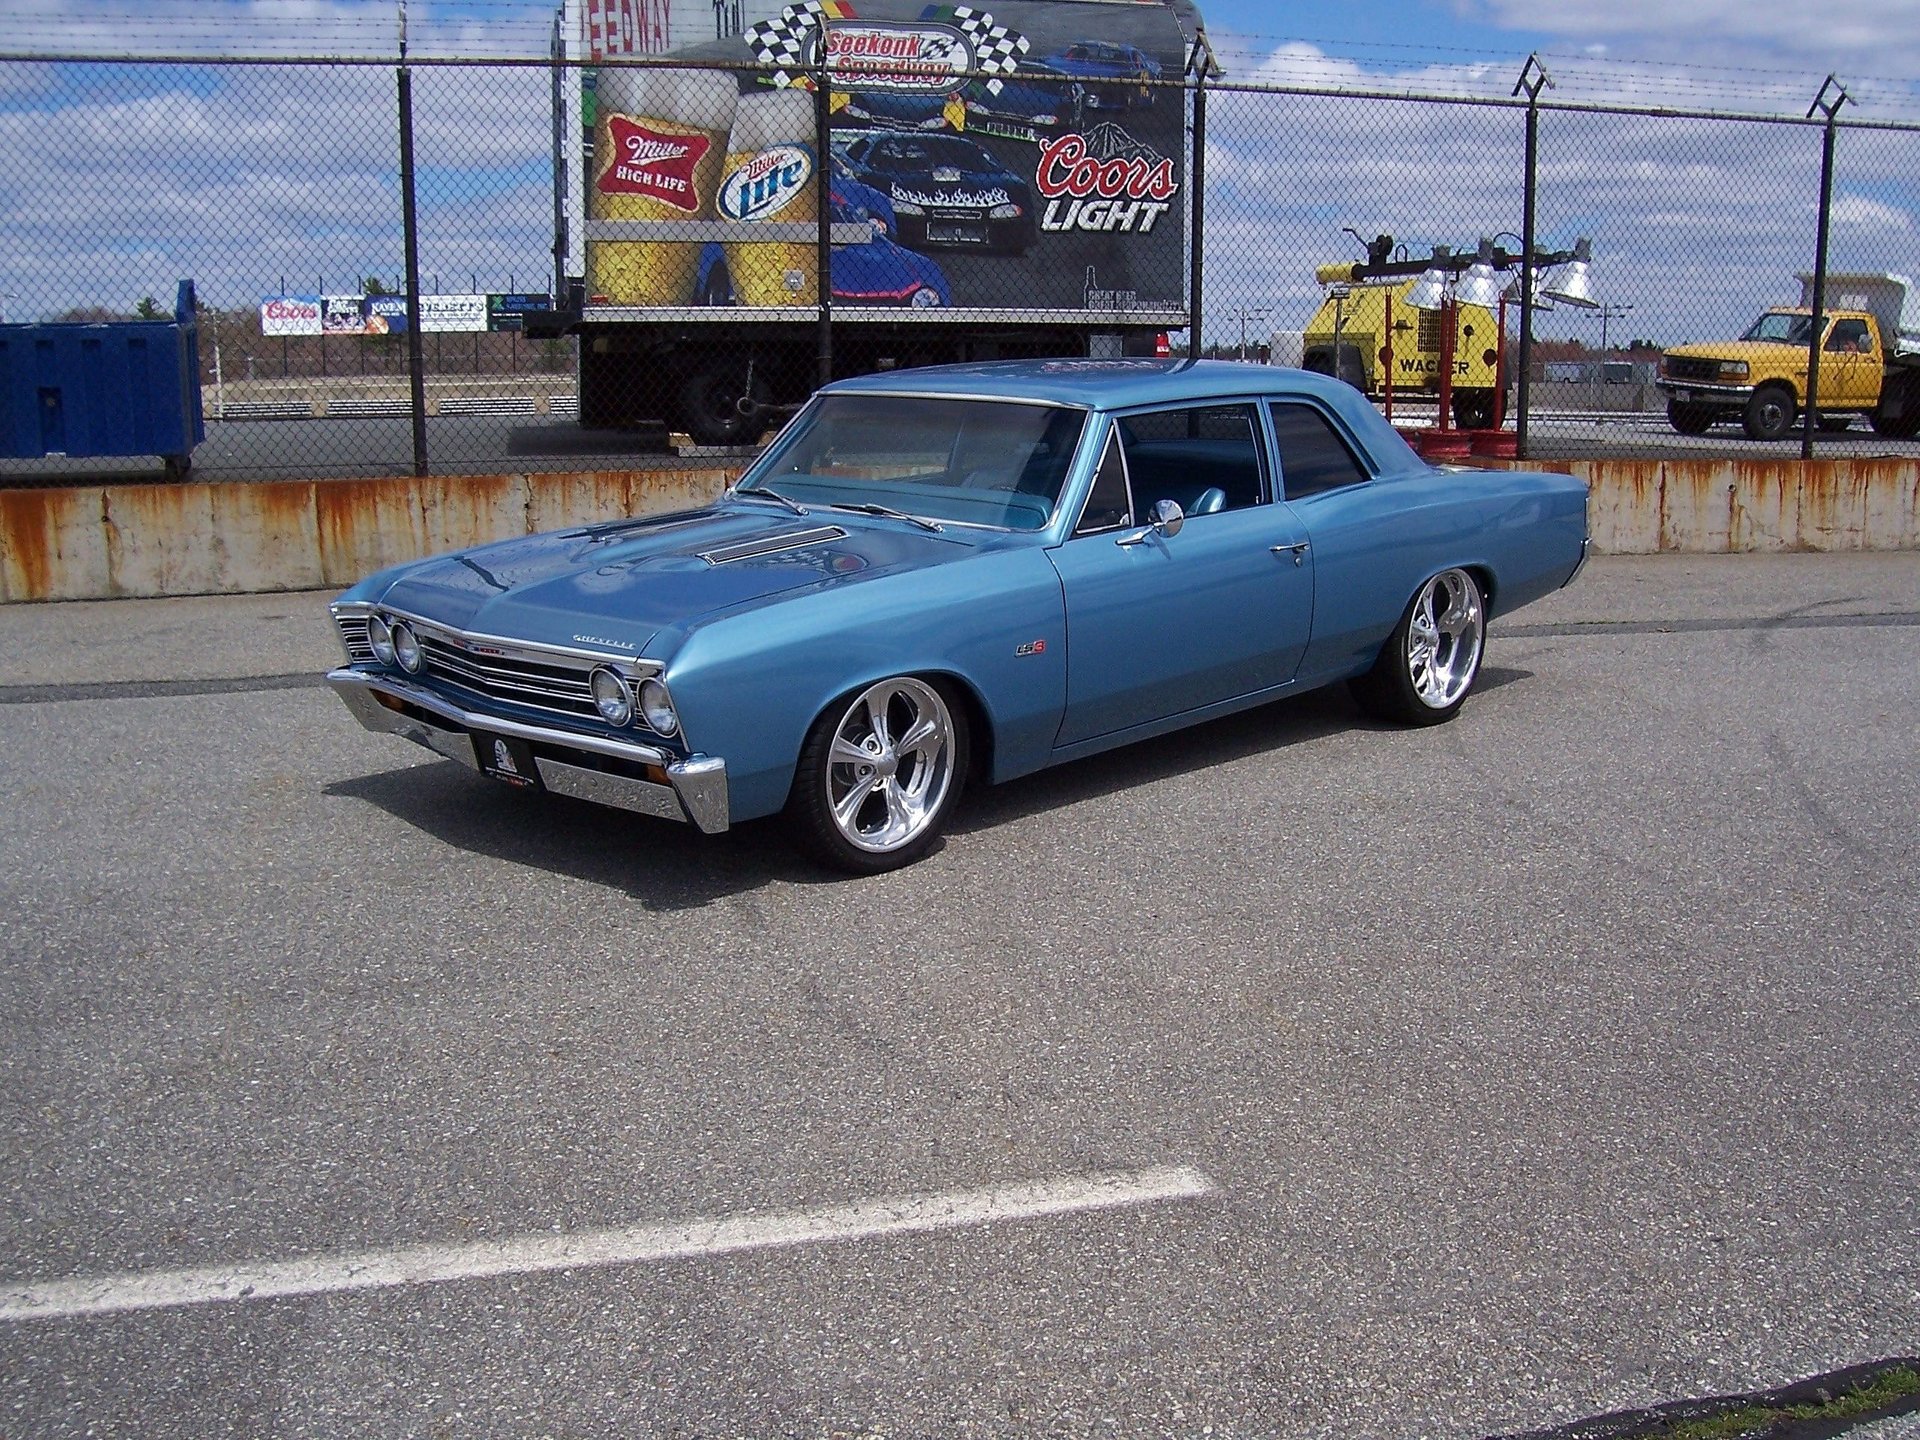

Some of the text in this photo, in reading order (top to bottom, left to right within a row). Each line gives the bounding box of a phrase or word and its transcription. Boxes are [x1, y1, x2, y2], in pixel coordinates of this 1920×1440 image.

[579, 0, 670, 63] EEDWAY
[826, 30, 921, 57] Seekonk
[626, 135, 689, 165] Miller
[741, 151, 788, 178] Miller
[616, 165, 688, 193] HIGH LIFE
[1036, 133, 1179, 199] Coors
[737, 159, 804, 220] Lite
[1040, 200, 1169, 232] LIGHT
[266, 300, 317, 320] Coors
[1400, 359, 1469, 375] WACER
